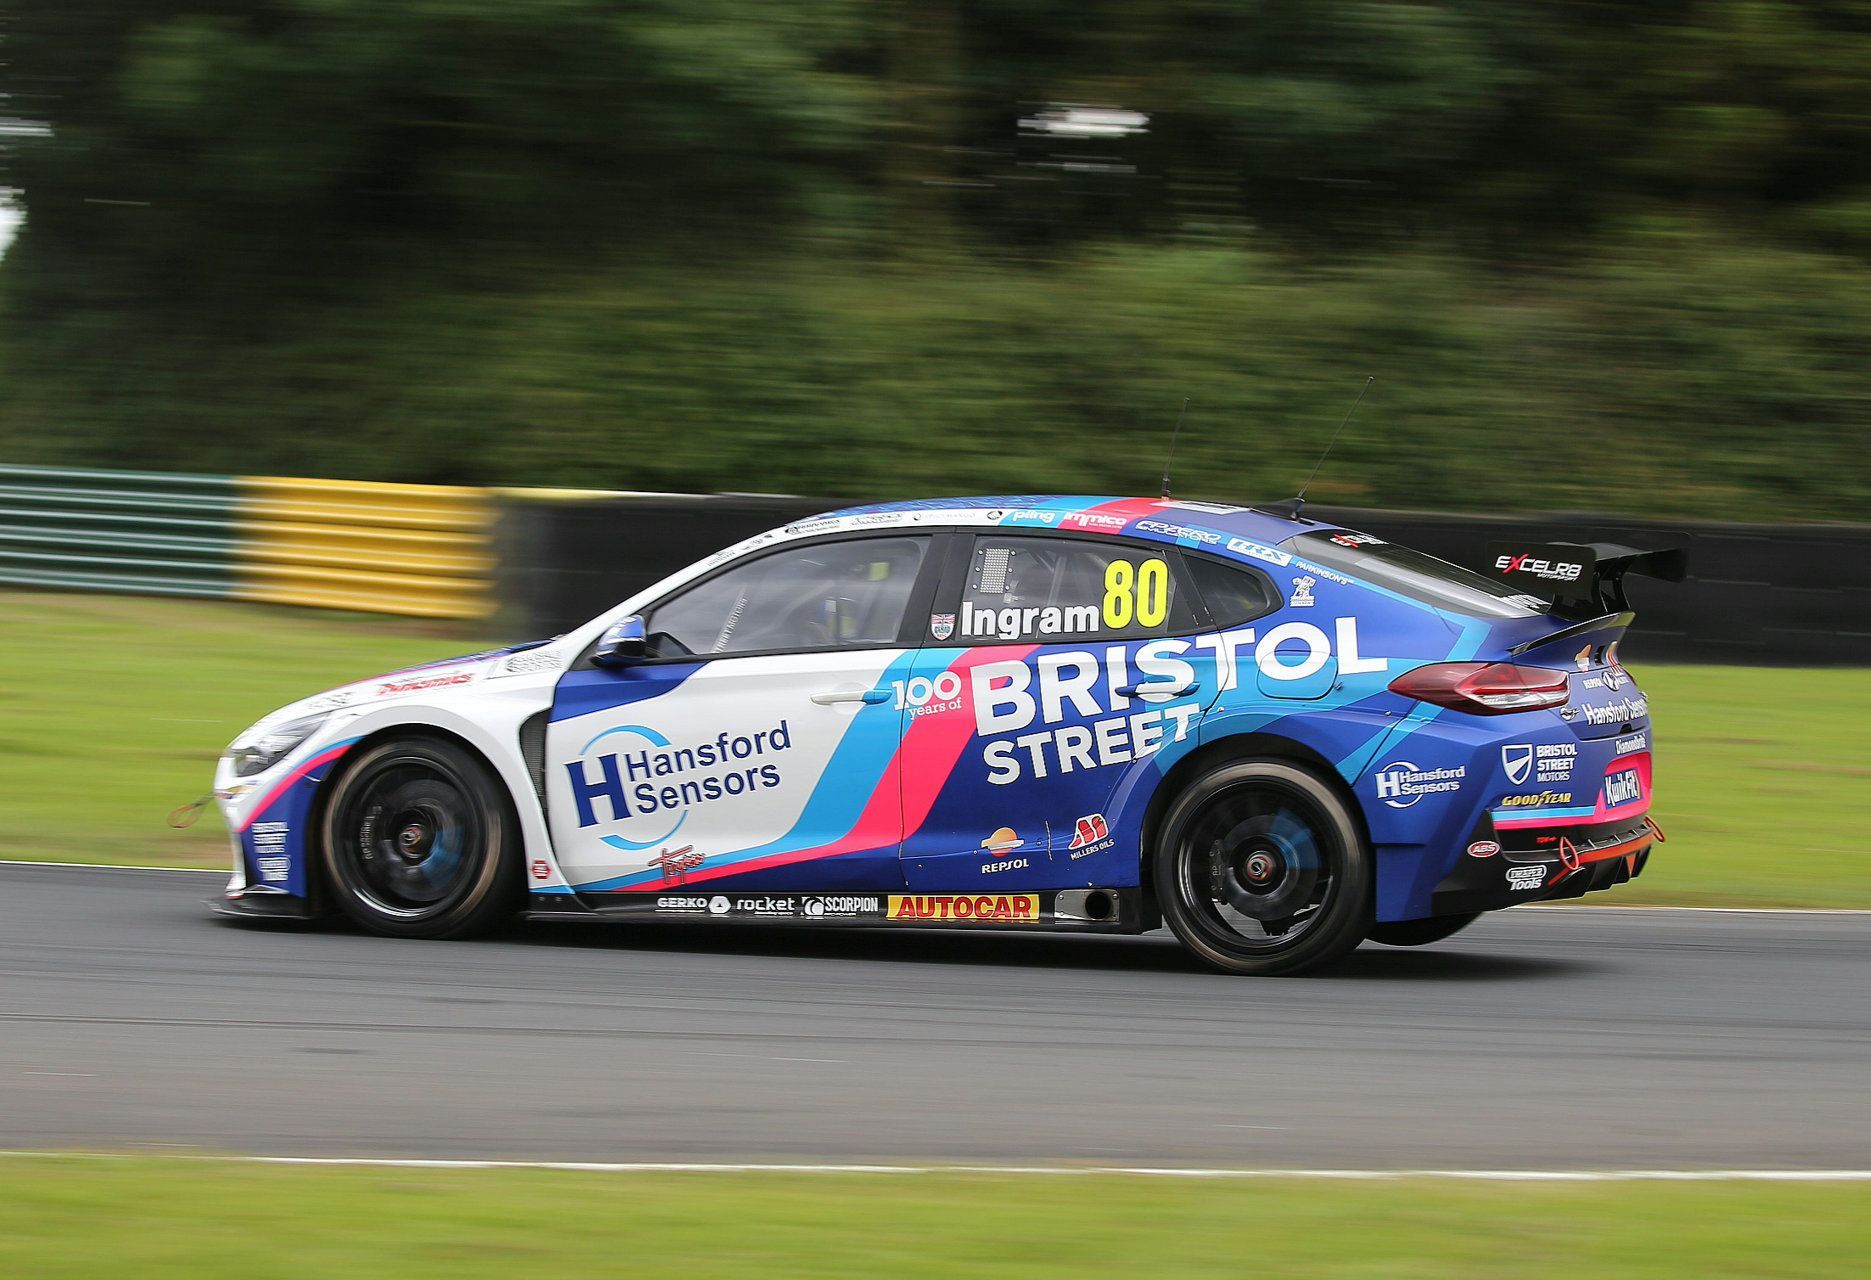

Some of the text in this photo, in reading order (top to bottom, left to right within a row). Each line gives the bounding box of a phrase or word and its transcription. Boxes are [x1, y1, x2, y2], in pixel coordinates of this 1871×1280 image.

[1494, 553, 1583, 578] EXCELR8
[1102, 558, 1169, 630] 80
[961, 601, 1100, 640] Ingram
[969, 616, 1389, 738] BRISTOL
[891, 671, 962, 711] 100
[908, 698, 962, 720] years of
[1582, 697, 1629, 726] Hansford
[625, 719, 792, 782] Hansford
[983, 702, 1203, 786] STREET
[1536, 743, 1578, 758] BRISTOL
[1536, 757, 1576, 771] STREET
[1399, 765, 1466, 784] Hansford
[1537, 771, 1571, 783] MOTORS
[634, 763, 781, 814] Sensors
[1400, 780, 1461, 796] Sensors
[1502, 790, 1572, 807] GOODYEAR
[1070, 838, 1115, 861] MILLERS OILS
[1472, 844, 1496, 853] ABS
[981, 858, 1030, 874] REPSOL
[1510, 867, 1544, 879] DRAPER
[1510, 878, 1542, 891] Tools
[657, 897, 708, 909] GERKO
[736, 896, 796, 911] rocket
[825, 896, 879, 912] SCORPION
[898, 896, 1032, 918] AUTOCAR
